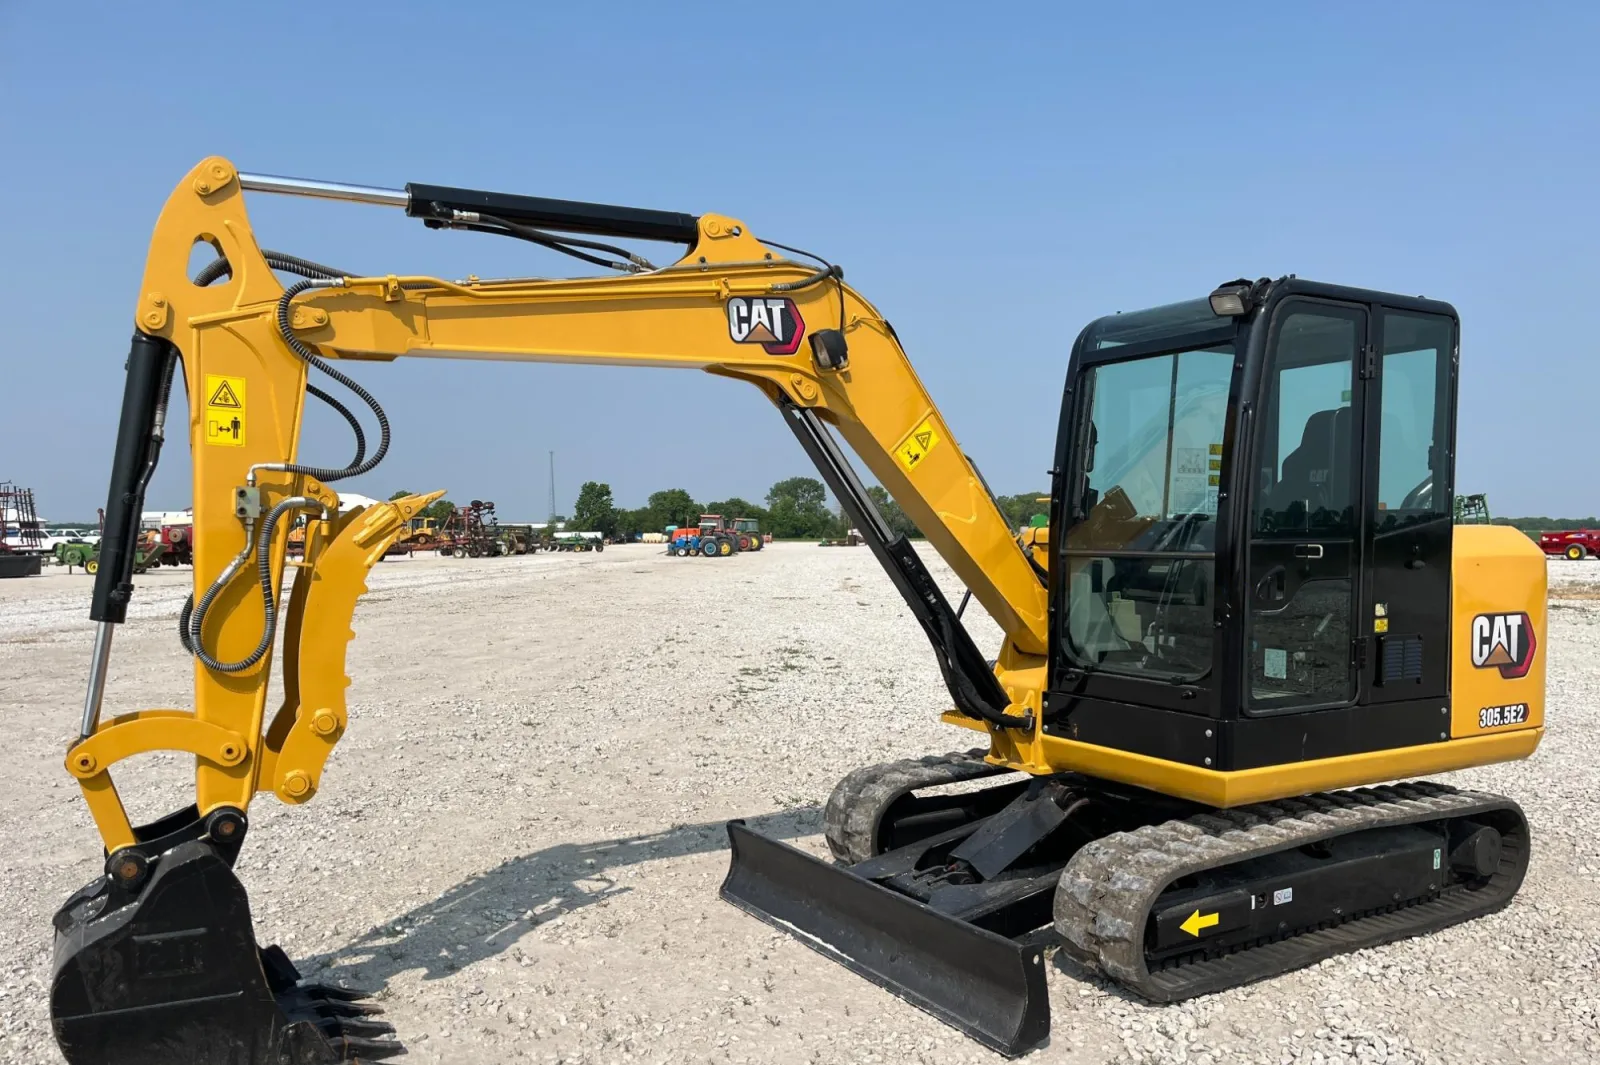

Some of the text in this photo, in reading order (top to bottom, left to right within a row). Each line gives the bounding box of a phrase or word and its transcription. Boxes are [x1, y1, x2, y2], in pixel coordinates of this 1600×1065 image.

[728, 297, 785, 342] CAT
[1472, 614, 1522, 667] CAT
[1479, 704, 1525, 728] 305.5E2
